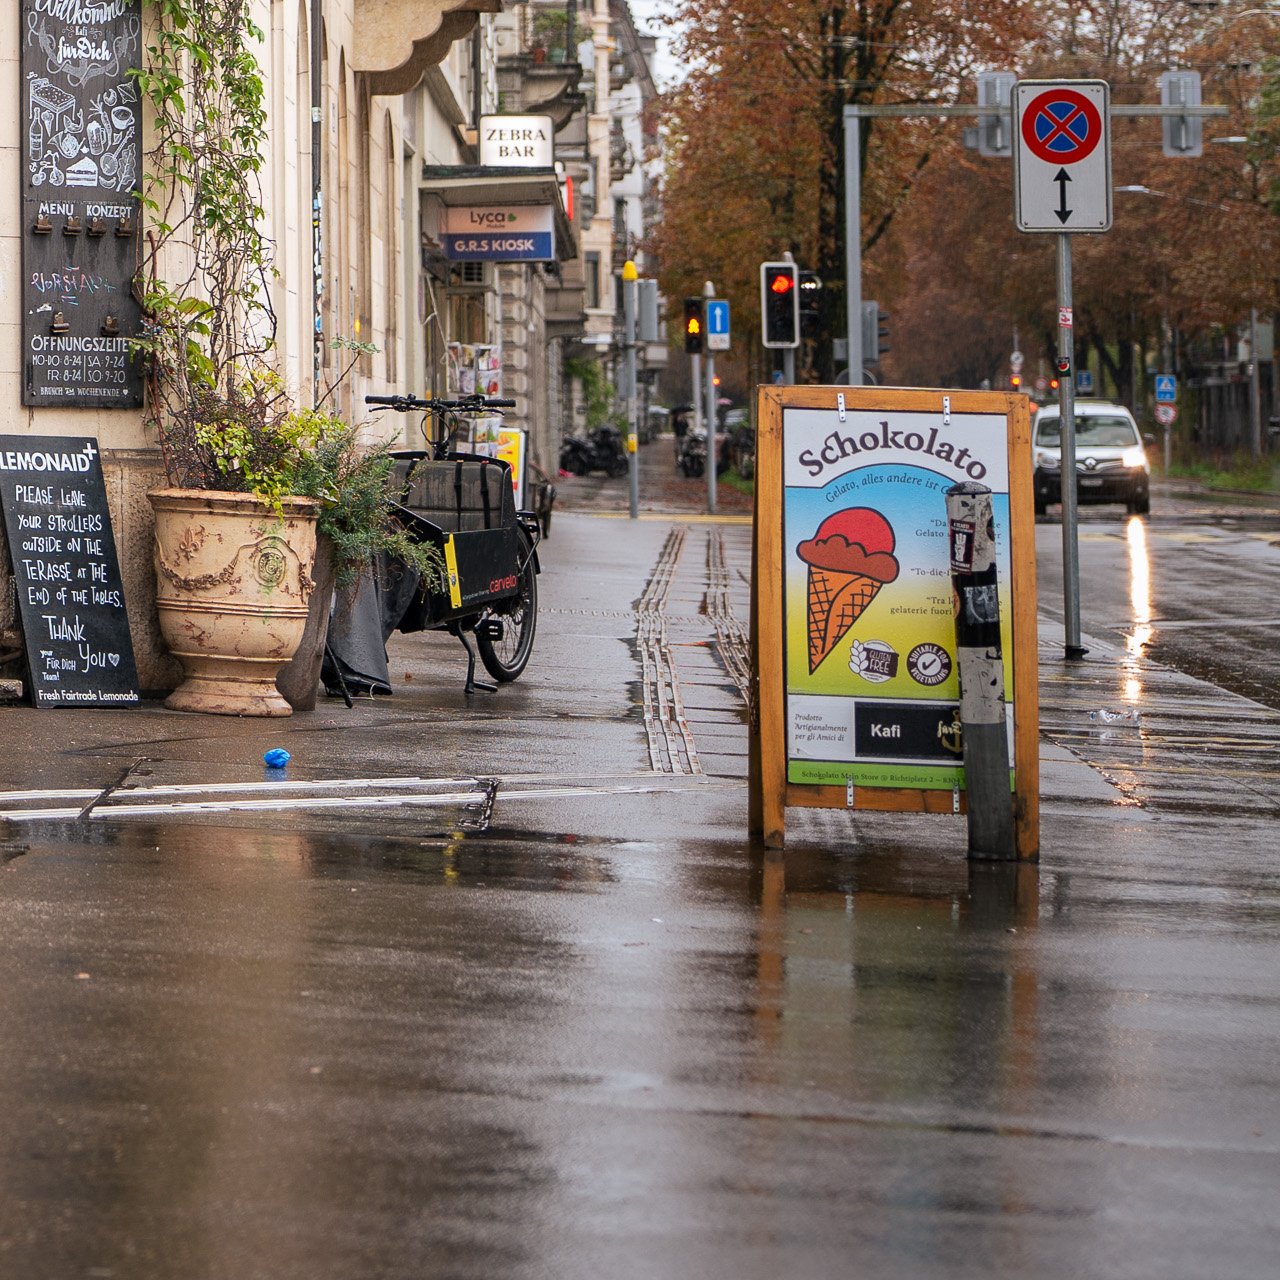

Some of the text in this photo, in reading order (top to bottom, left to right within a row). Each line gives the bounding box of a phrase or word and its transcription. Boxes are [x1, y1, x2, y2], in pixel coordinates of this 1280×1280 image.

[486, 127, 547, 142] ZEBRA
[498, 145, 536, 158] BAR
[38, 202, 133, 219] MENU KONZERT
[470, 210, 506, 226] Lyca
[492, 238, 536, 252] KIOSK
[30, 334, 130, 353] ÖFFNUNGSZEITE
[63, 354, 82, 366] 8-24
[105, 355, 125, 368] 9-24
[63, 369, 82, 382] 8-24
[105, 370, 126, 383] 9-20
[798, 420, 988, 480] Schokolato
[15, 484, 54, 505] PLEASE
[825, 478, 860, 504] Gelato,
[861, 473, 884, 487] alles
[886, 472, 923, 487] andere
[925, 477, 939, 491] ist
[915, 528, 945, 538] Gelato
[83, 538, 104, 556] THE
[77, 568, 87, 579] AT
[88, 562, 108, 583] THE
[489, 574, 518, 593] carvelo
[28, 586, 49, 605] END
[71, 589, 88, 605] THE
[889, 605, 953, 616] gelaterie fuori
[869, 650, 892, 662] GLUTEN
[909, 644, 936, 664] SUITABLE
[936, 647, 950, 664] FOR
[869, 658, 891, 674] FREE
[910, 666, 950, 685] VEGETARIANS
[38, 689, 139, 701] Fresh Fairtrade Lemonade
[794, 713, 823, 722] Prodotto
[794, 733, 806, 741] per
[806, 733, 816, 741] gli
[817, 733, 836, 742] Amici
[870, 723, 901, 738] Kafi
[801, 771, 839, 781] Schokolato
[861, 773, 879, 781] Store
[890, 774, 927, 785] Richtiplatz
